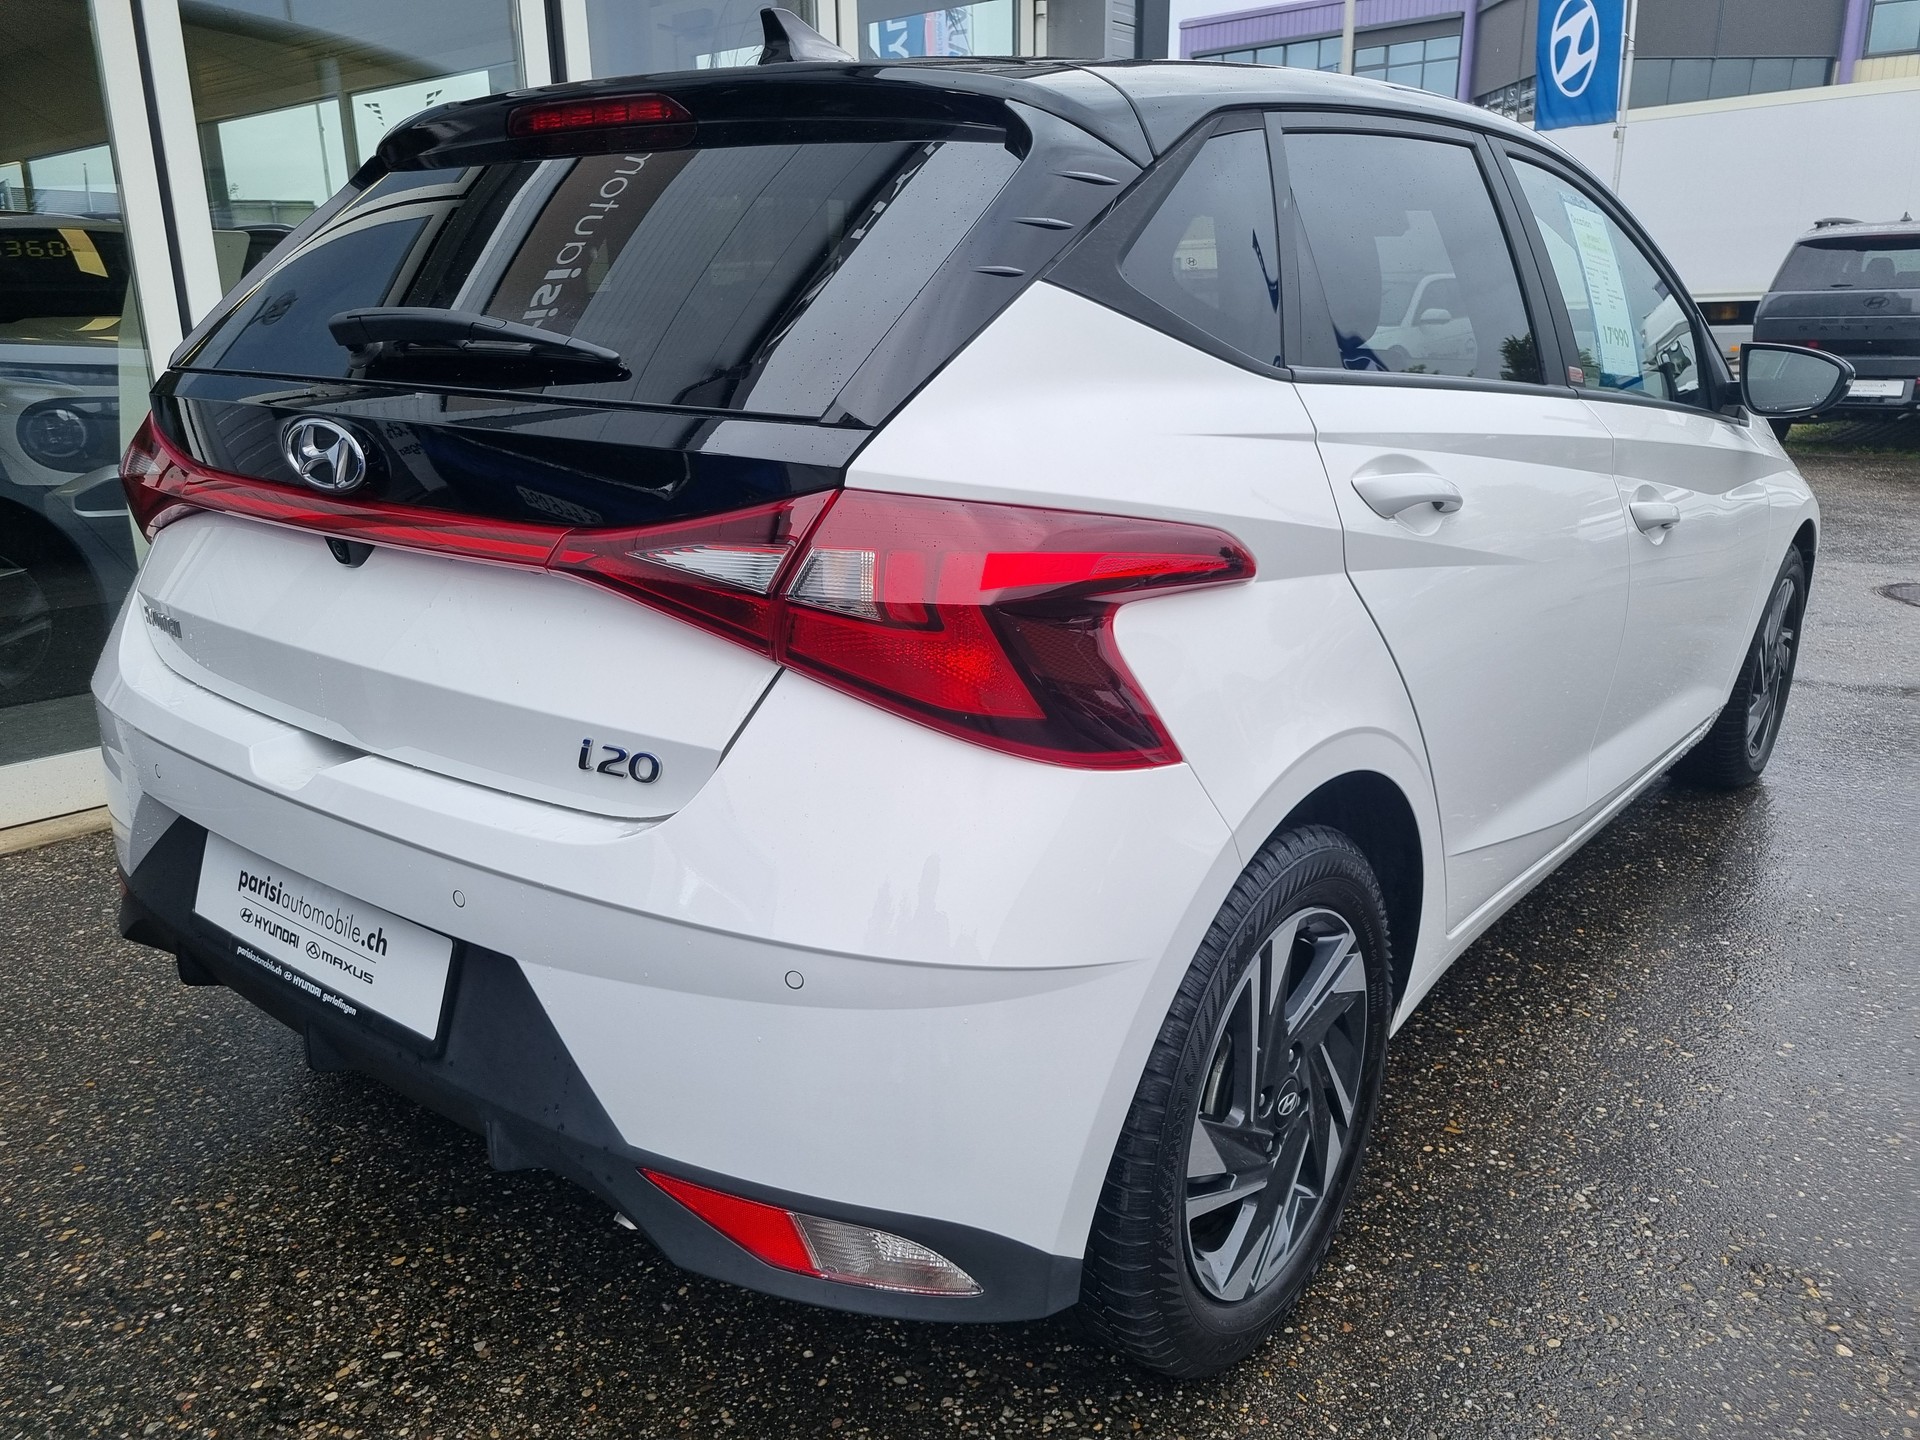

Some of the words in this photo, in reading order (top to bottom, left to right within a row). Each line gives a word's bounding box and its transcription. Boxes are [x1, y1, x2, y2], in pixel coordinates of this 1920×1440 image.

[578, 737, 663, 785] i20
[237, 869, 388, 957] parisiautomobile.ch
[236, 945, 283, 976] parisiautomobile.ch
[292, 974, 322, 998] HYUNDAI
[322, 991, 357, 1016] gerlafingen
[254, 914, 300, 949] HYUNDAI
[321, 950, 375, 985] MAXUS
